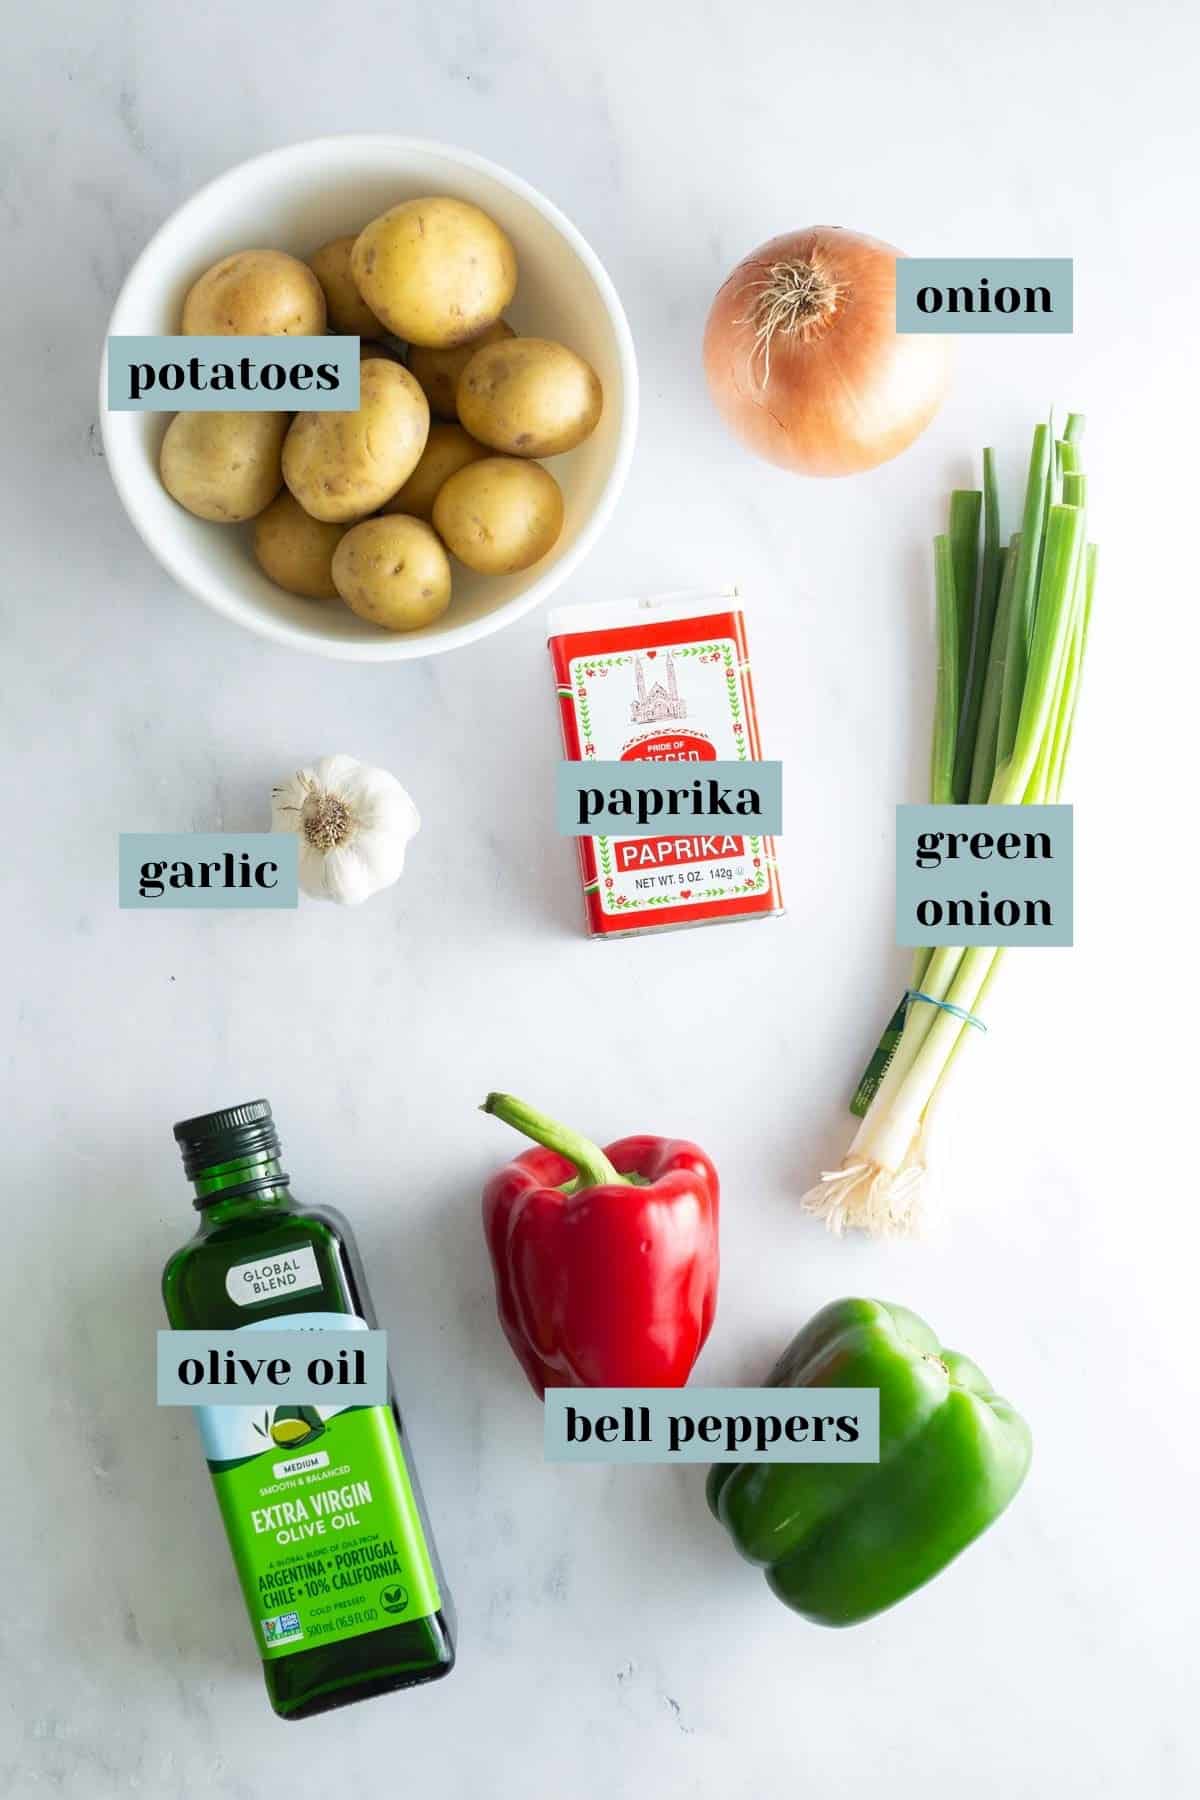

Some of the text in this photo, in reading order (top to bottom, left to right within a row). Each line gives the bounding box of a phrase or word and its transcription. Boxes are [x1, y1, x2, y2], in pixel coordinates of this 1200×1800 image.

[622, 836, 738, 867] PAPRIKA
[635, 868, 732, 889] NET WT. 5 OZ. 142g
[243, 1259, 301, 1282] GLOBAL
[253, 1274, 297, 1294] BLEND
[259, 1479, 297, 1496] SMOOTH
[306, 1465, 350, 1484] BALANCED
[283, 1457, 319, 1473] MEDIUM
[251, 1480, 373, 1533] EXTRA VIRGIN
[276, 1512, 360, 1545] OLIVE OIL
[258, 1540, 398, 1592] ARGENTINA PORTUGAL
[263, 1560, 402, 1610] CHILE 10% CALIFORNIA
